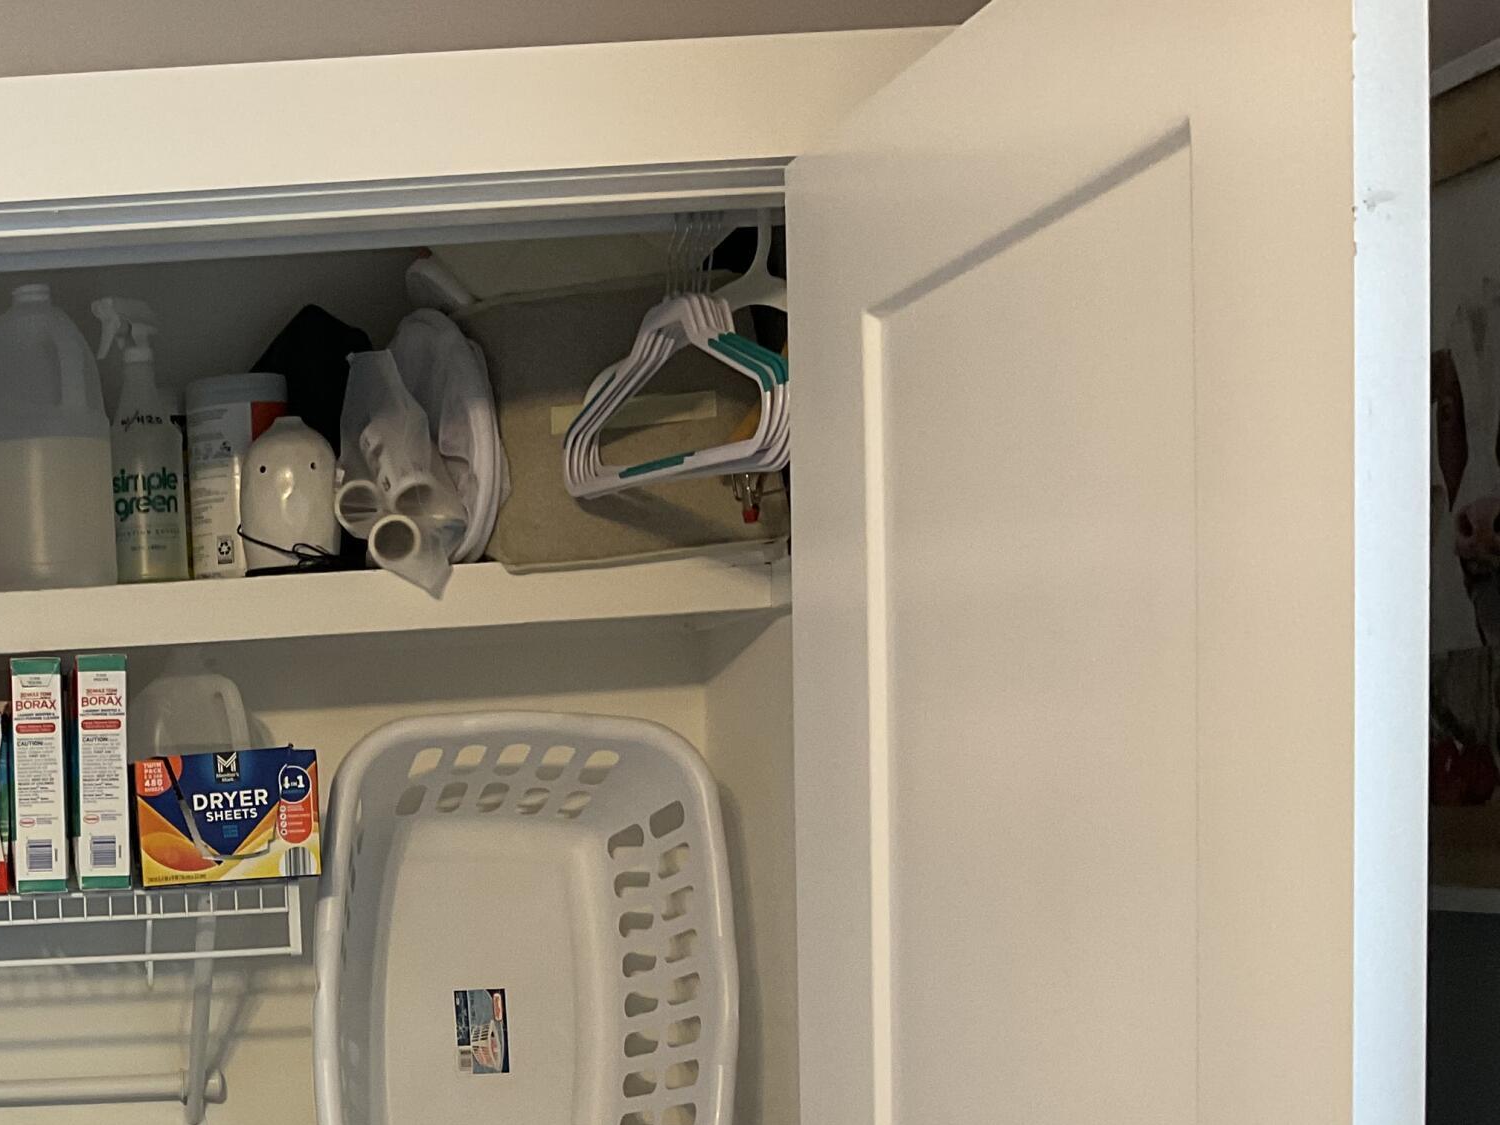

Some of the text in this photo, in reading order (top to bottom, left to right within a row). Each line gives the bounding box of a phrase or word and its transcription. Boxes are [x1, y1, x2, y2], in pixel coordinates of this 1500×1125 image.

[113, 467, 178, 495] simple
[115, 495, 178, 522] green
[16, 699, 56, 711] BORAX
[82, 696, 122, 707] BORAX
[192, 789, 269, 811] DRYER
[205, 808, 258, 822] SHEETS
